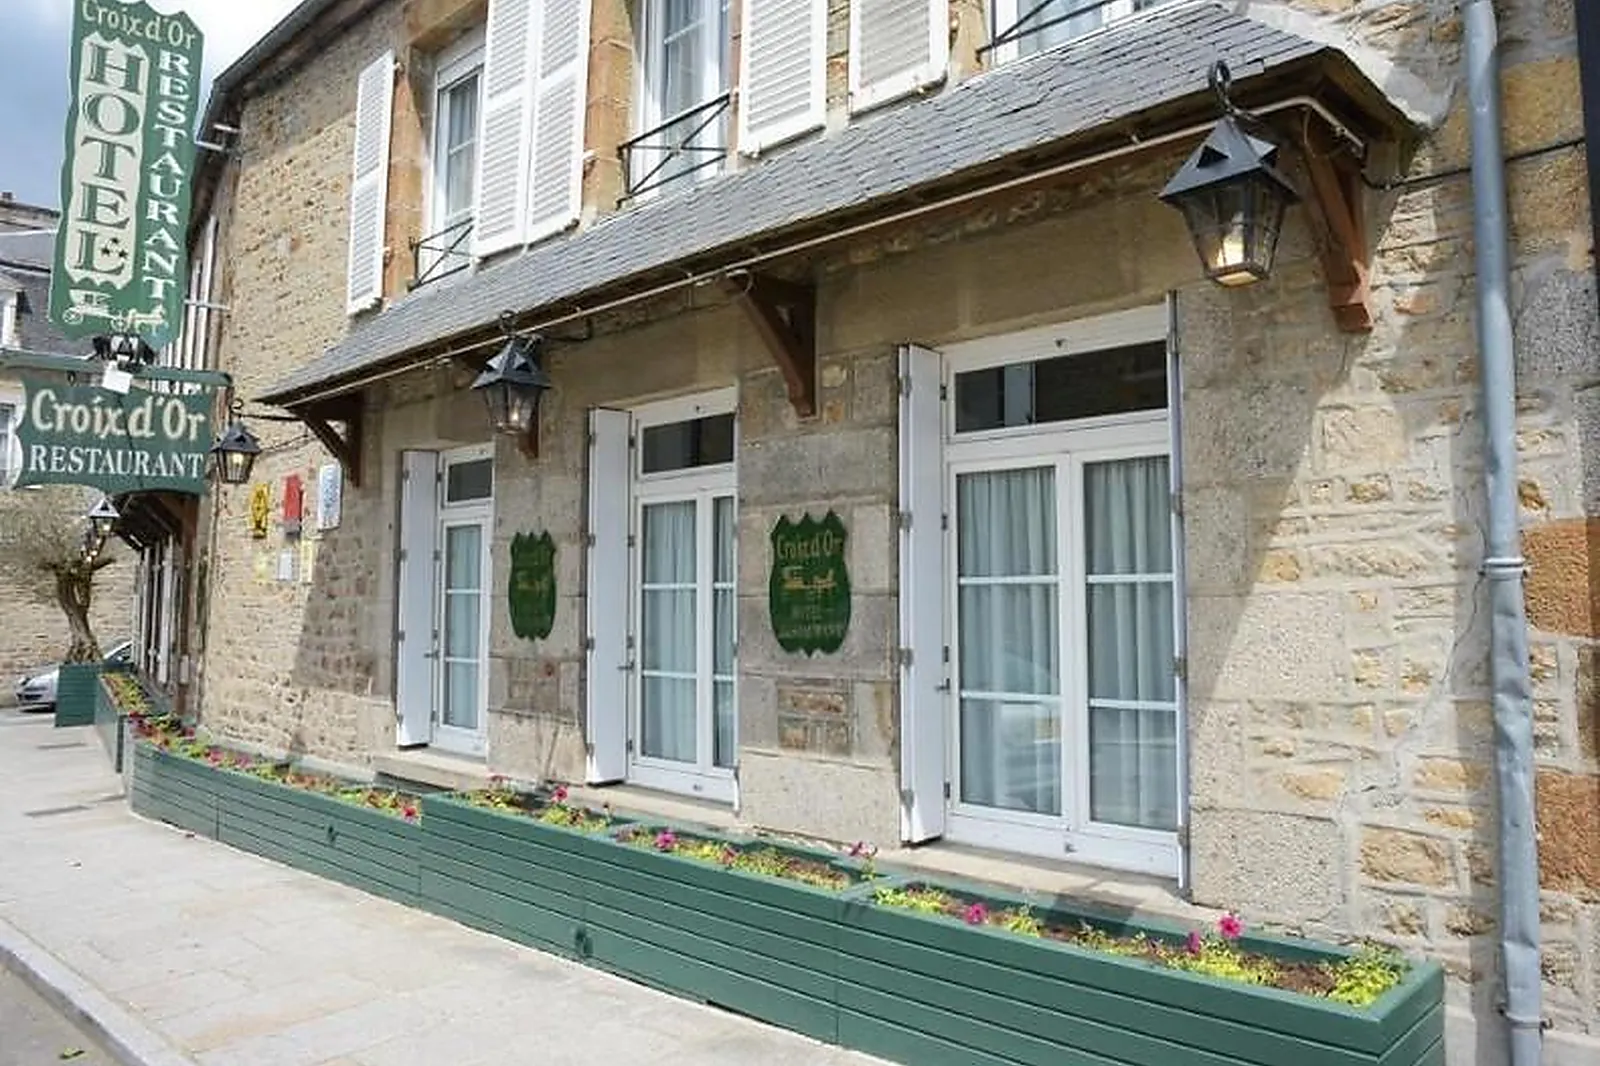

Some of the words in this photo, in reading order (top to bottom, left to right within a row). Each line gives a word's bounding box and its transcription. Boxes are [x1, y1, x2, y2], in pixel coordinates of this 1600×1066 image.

[74, 42, 146, 276] HOTEL
[142, 49, 190, 300] RESTAURANT
[29, 444, 203, 478] RESTAURANT
